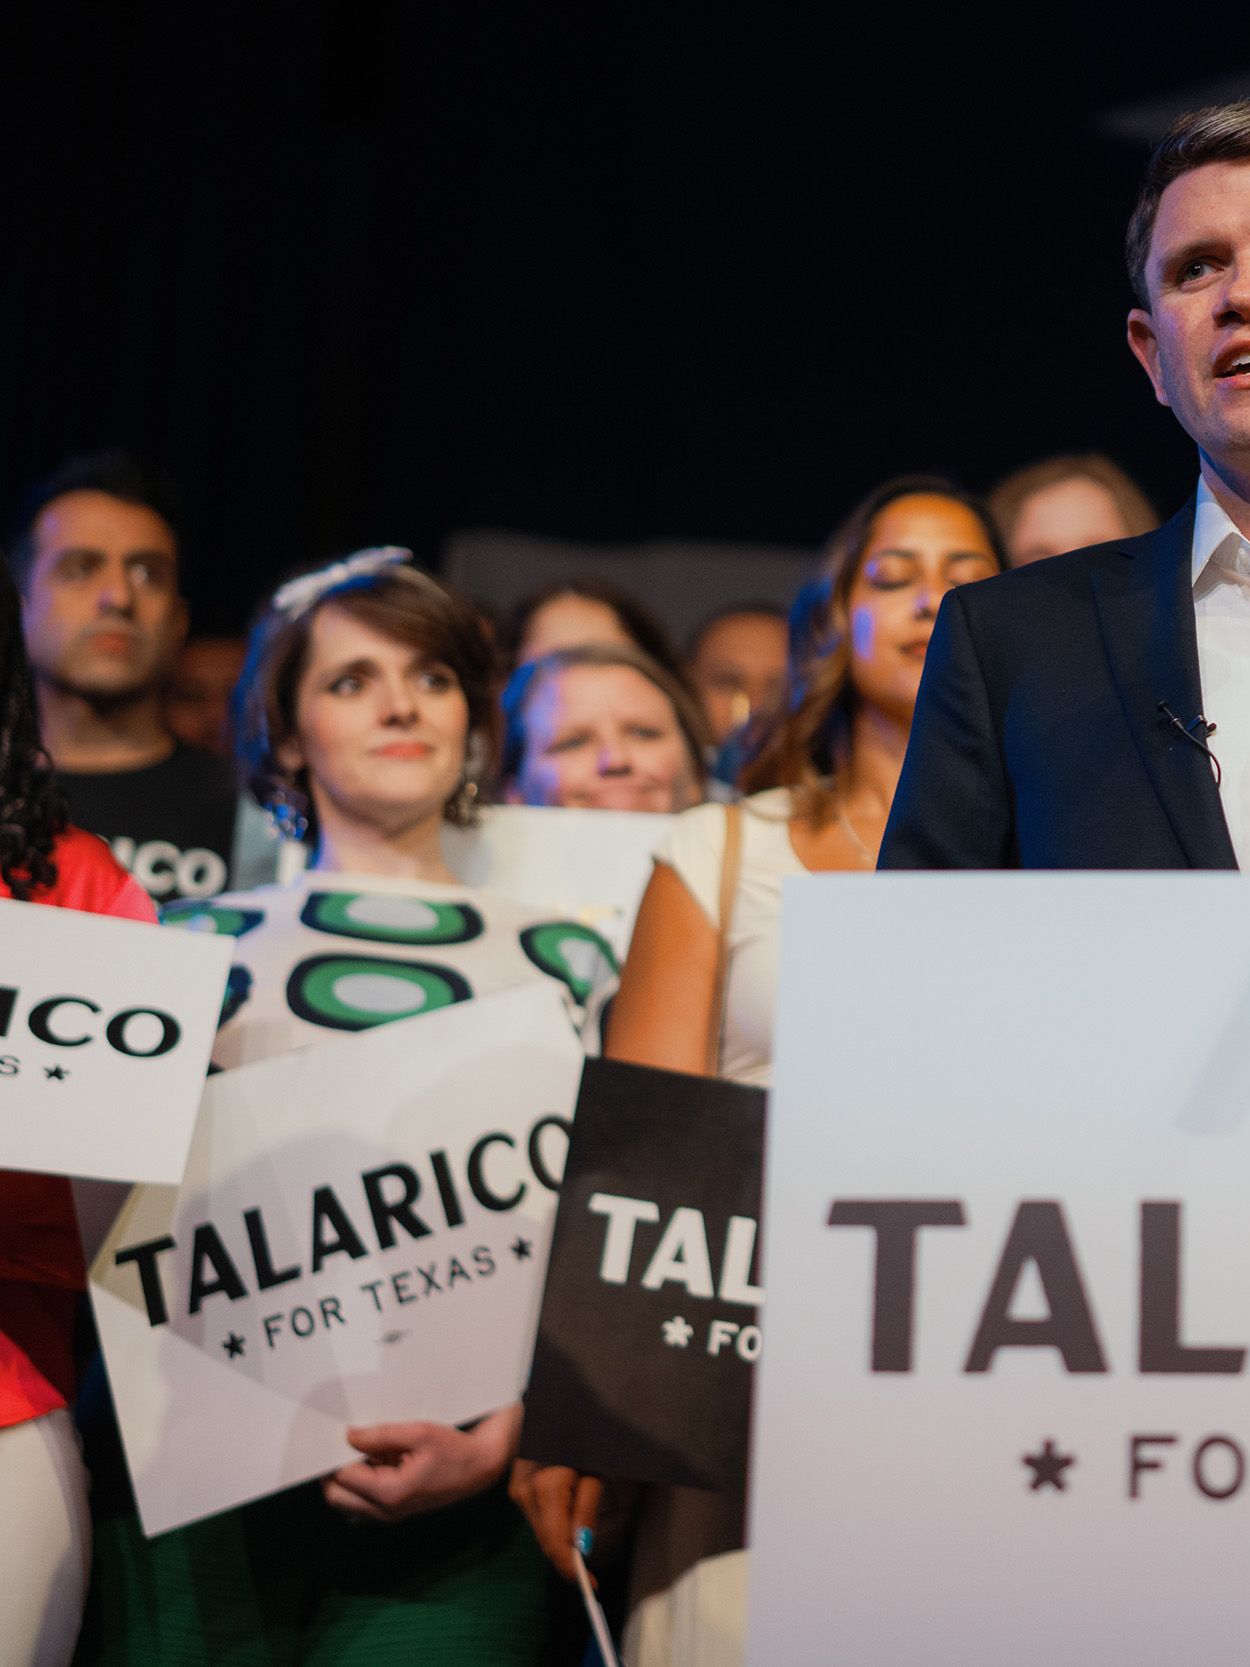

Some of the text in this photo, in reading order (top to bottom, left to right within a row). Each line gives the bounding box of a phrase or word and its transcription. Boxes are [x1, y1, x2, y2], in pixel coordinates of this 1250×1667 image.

[114, 1115, 569, 1328] TALARICO
[588, 1192, 768, 1307] TAL
[262, 1245, 497, 1349] FOR TEXAS
[707, 1319, 763, 1371] FO
